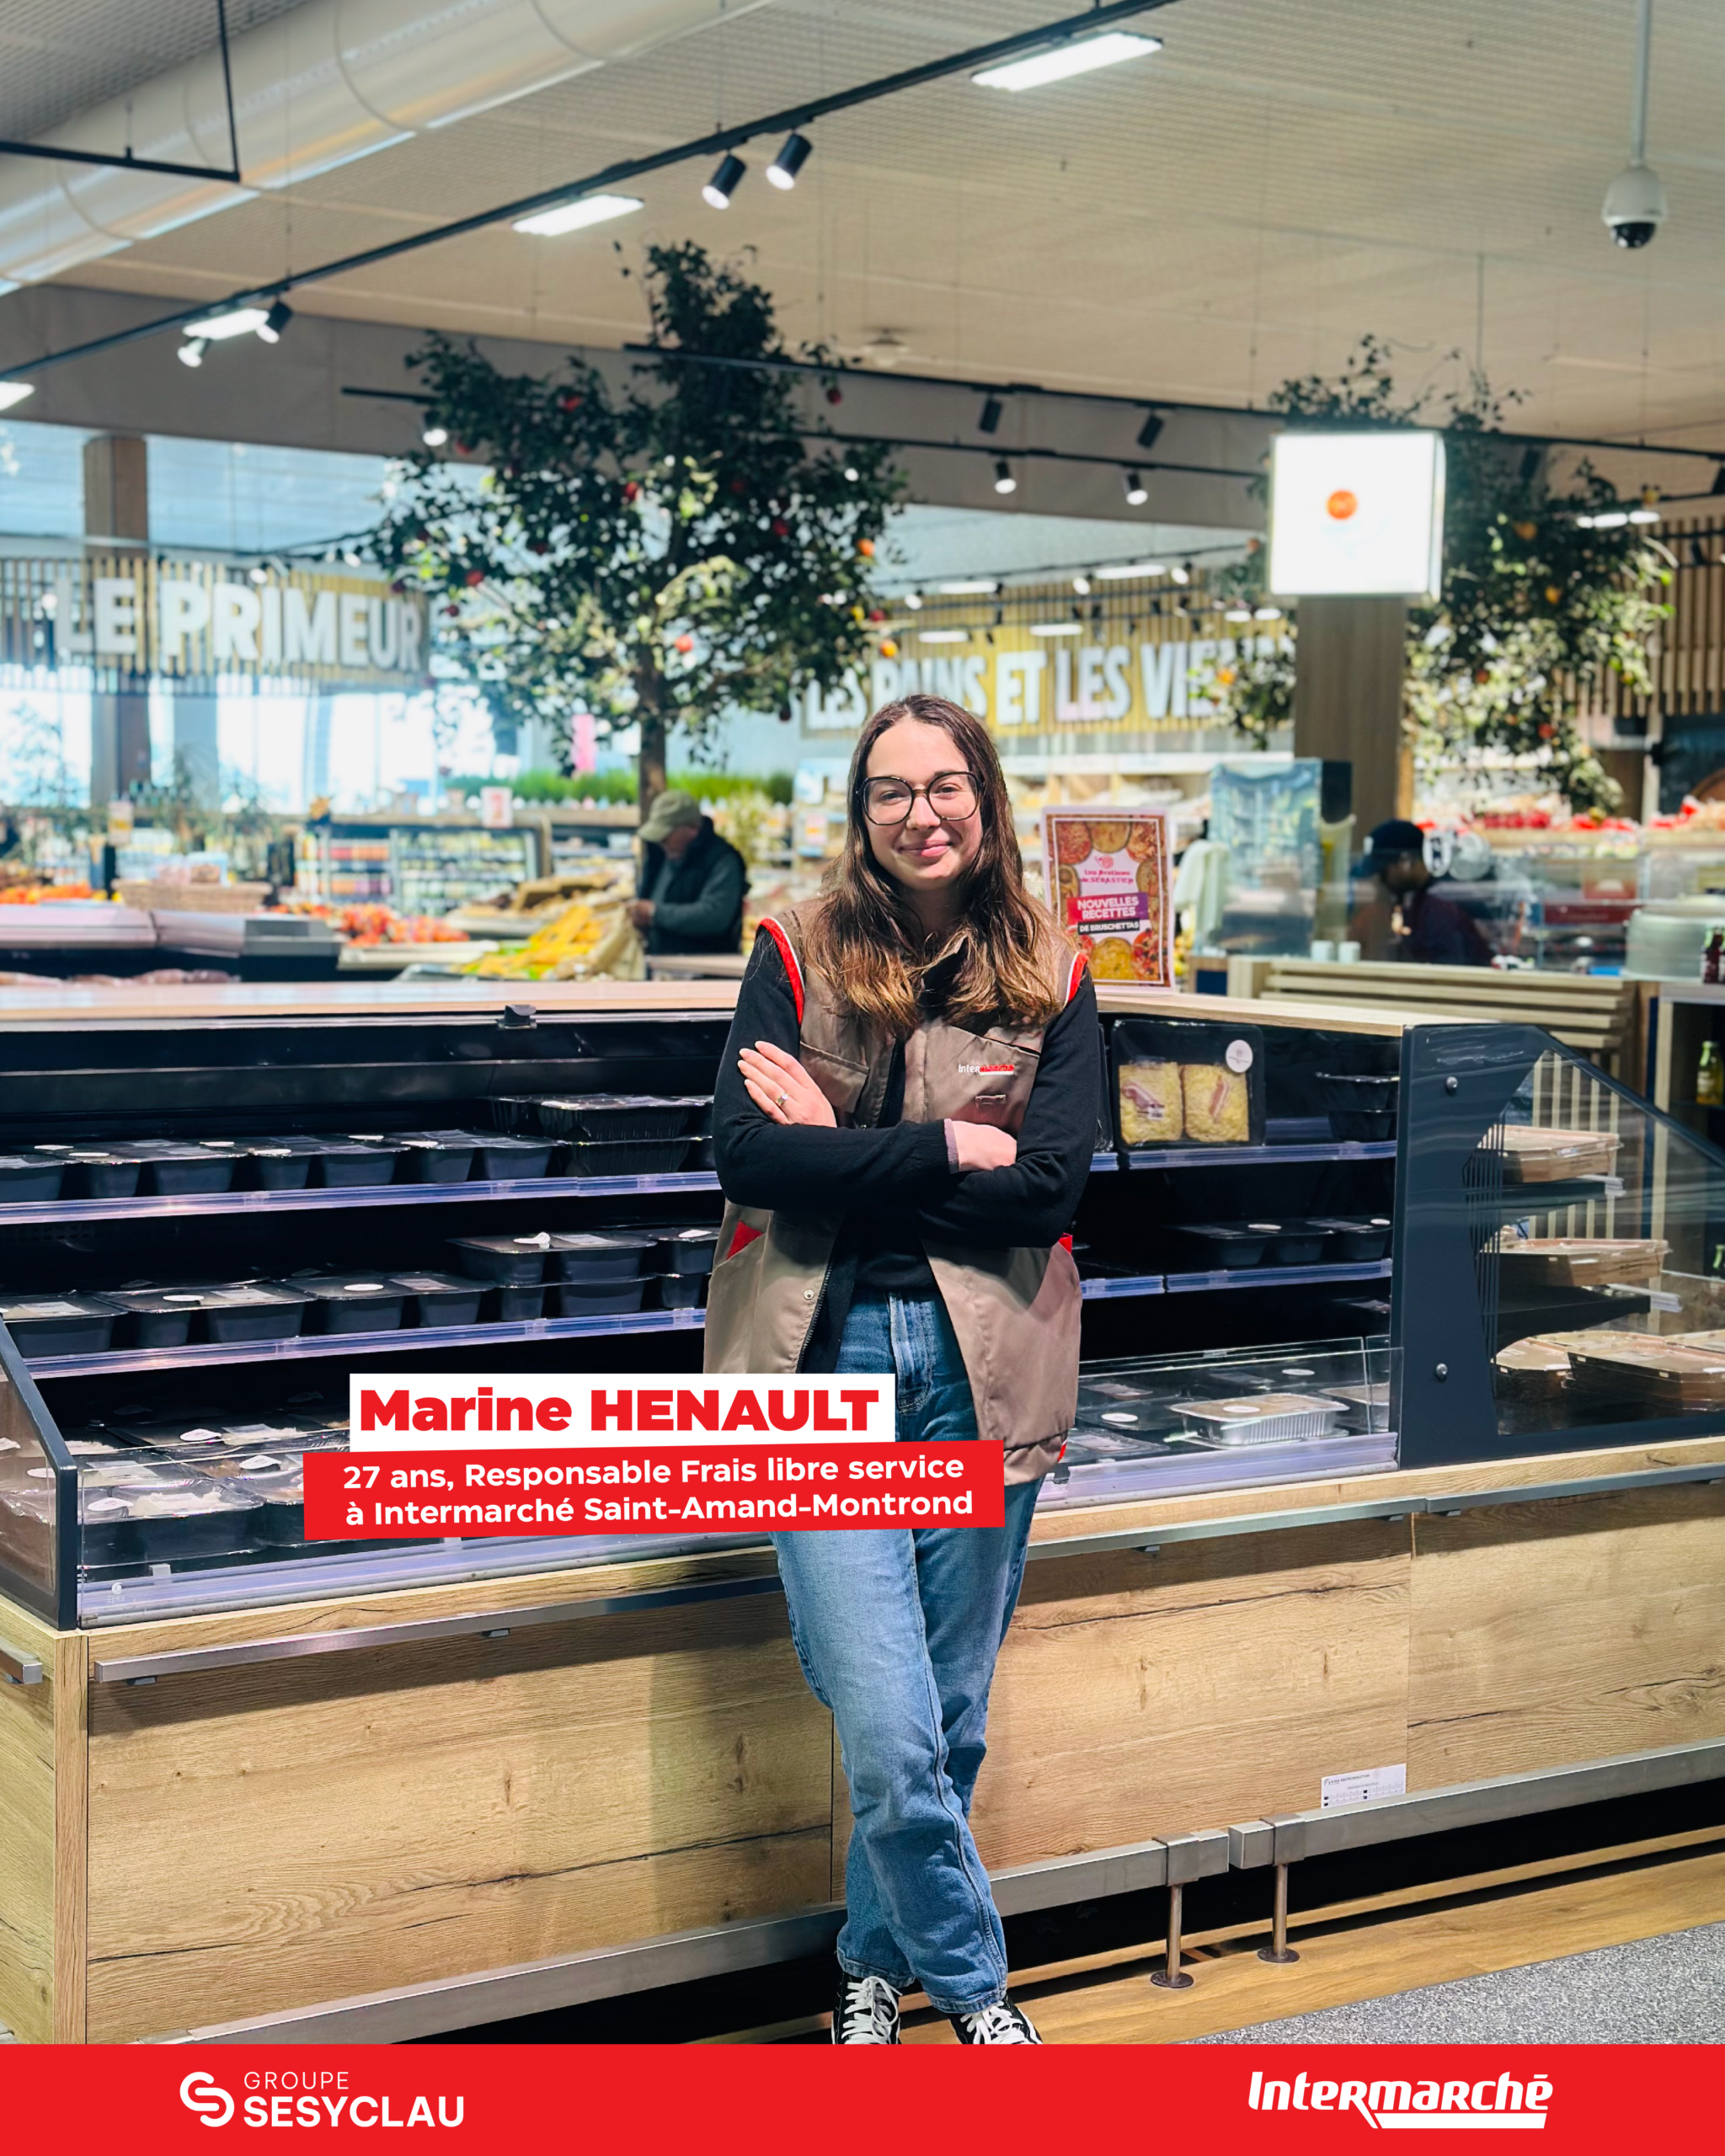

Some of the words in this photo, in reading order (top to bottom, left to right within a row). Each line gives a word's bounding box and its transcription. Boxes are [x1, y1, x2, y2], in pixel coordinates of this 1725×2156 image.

[57, 578, 136, 654] LE
[159, 580, 422, 671] PRIMEUR
[996, 649, 1047, 725] ET
[1055, 645, 1131, 723] LES
[1076, 896, 1140, 910] NOUVELLES
[1082, 906, 1136, 921] RECETTES
[1091, 922, 1139, 931] BRUSCHETTAS
